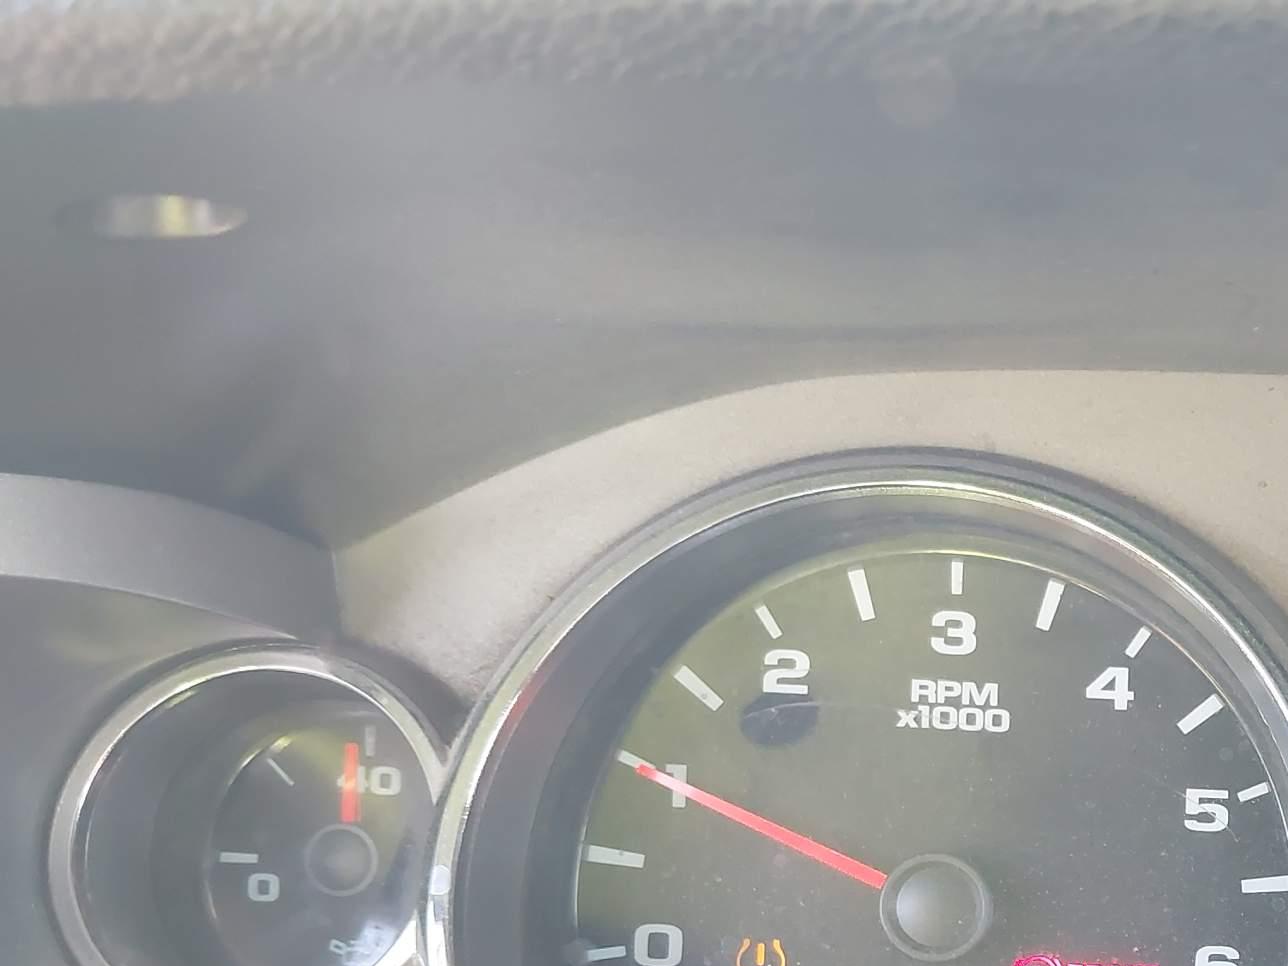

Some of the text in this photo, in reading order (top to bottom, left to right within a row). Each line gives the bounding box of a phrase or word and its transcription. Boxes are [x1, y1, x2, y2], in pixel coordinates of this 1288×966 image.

[930, 611, 977, 655] 3
[762, 649, 811, 695] 2
[911, 679, 999, 706] RPM
[1086, 667, 1134, 710] 4
[896, 706, 1010, 733] x1000
[665, 764, 688, 808] 1
[1184, 788, 1229, 832] 5
[247, 873, 280, 902] 0
